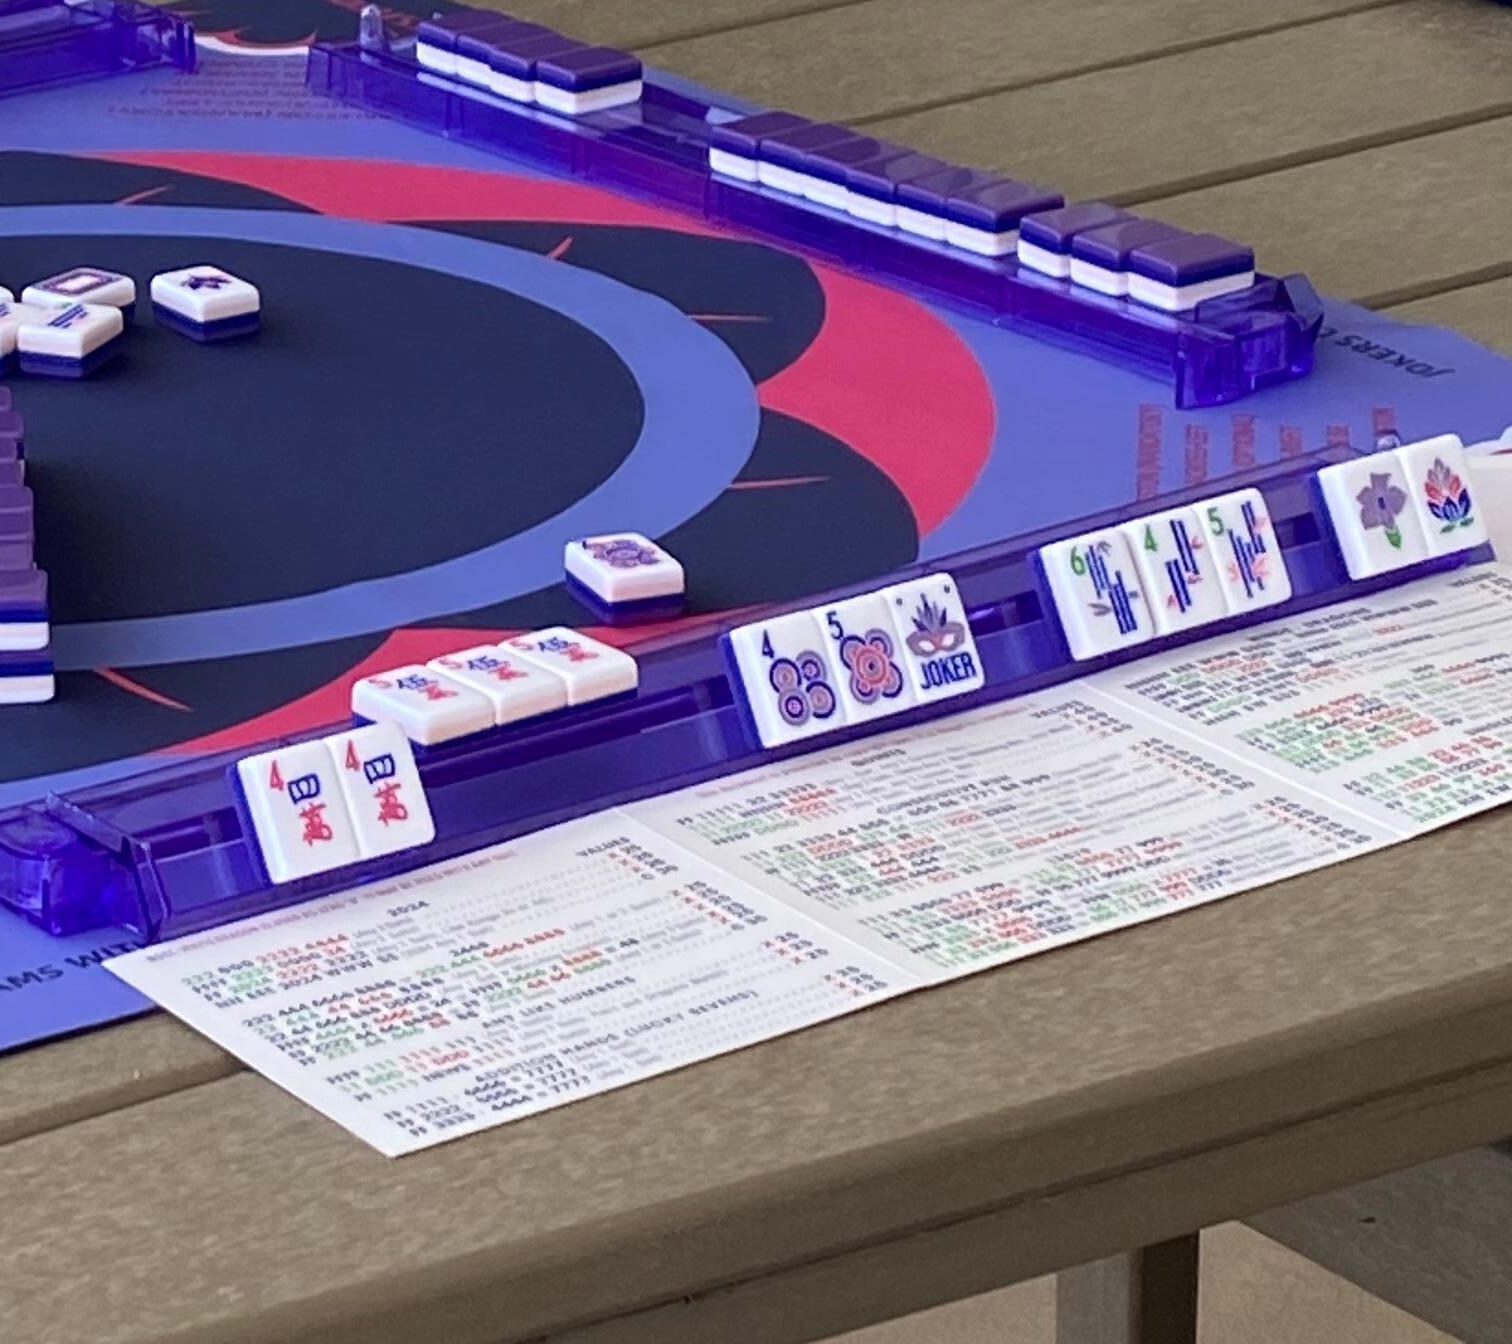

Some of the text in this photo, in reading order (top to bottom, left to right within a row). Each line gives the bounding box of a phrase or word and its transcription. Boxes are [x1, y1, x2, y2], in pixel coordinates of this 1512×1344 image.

[1334, 334, 1457, 378] JOKERS
[1207, 506, 1224, 537] 5
[1144, 523, 1159, 553] 4
[1070, 546, 1087, 577] 6
[826, 610, 845, 641] 5
[761, 629, 775, 660] 4
[919, 651, 978, 691] JOKER
[345, 738, 361, 771] 4
[269, 759, 285, 791] 4
